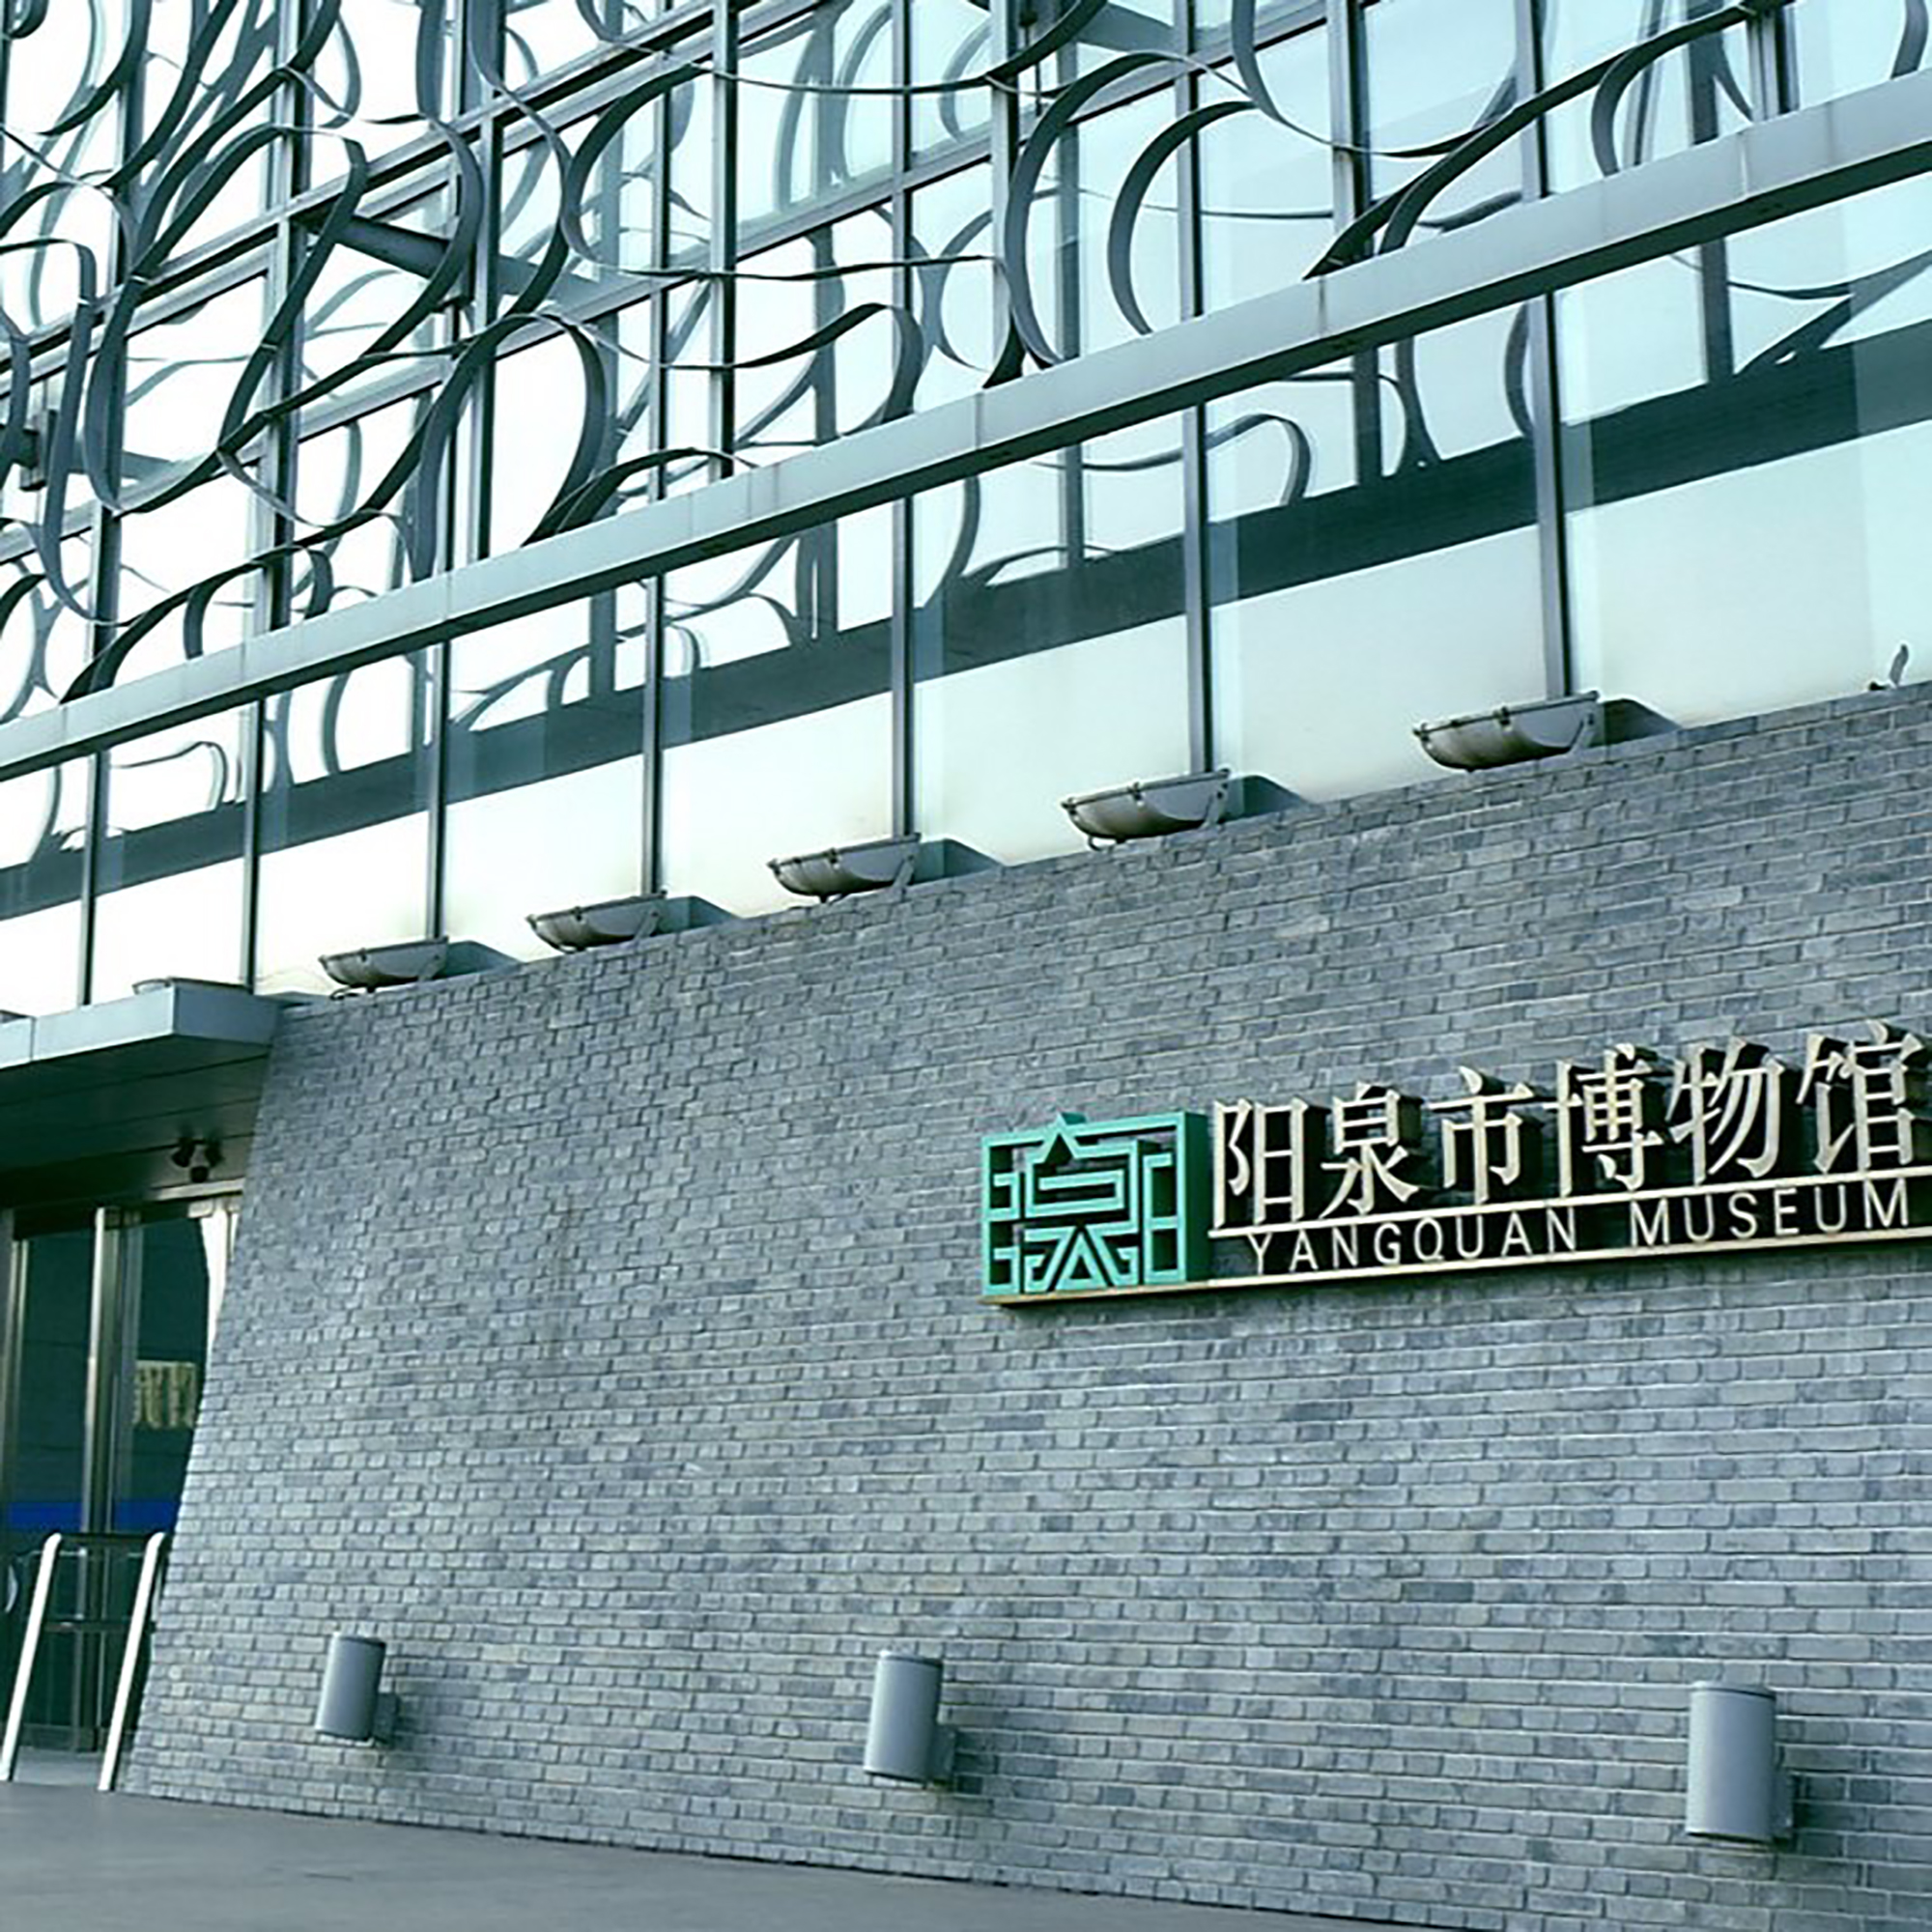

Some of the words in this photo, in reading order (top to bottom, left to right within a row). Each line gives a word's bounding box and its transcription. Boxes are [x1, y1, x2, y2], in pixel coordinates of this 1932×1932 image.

[1213, 1020, 1923, 1230] 阳泉市博物馆
[1247, 1207, 1576, 1274] YANGQUAN
[1631, 1178, 1909, 1247] MUSEUM
